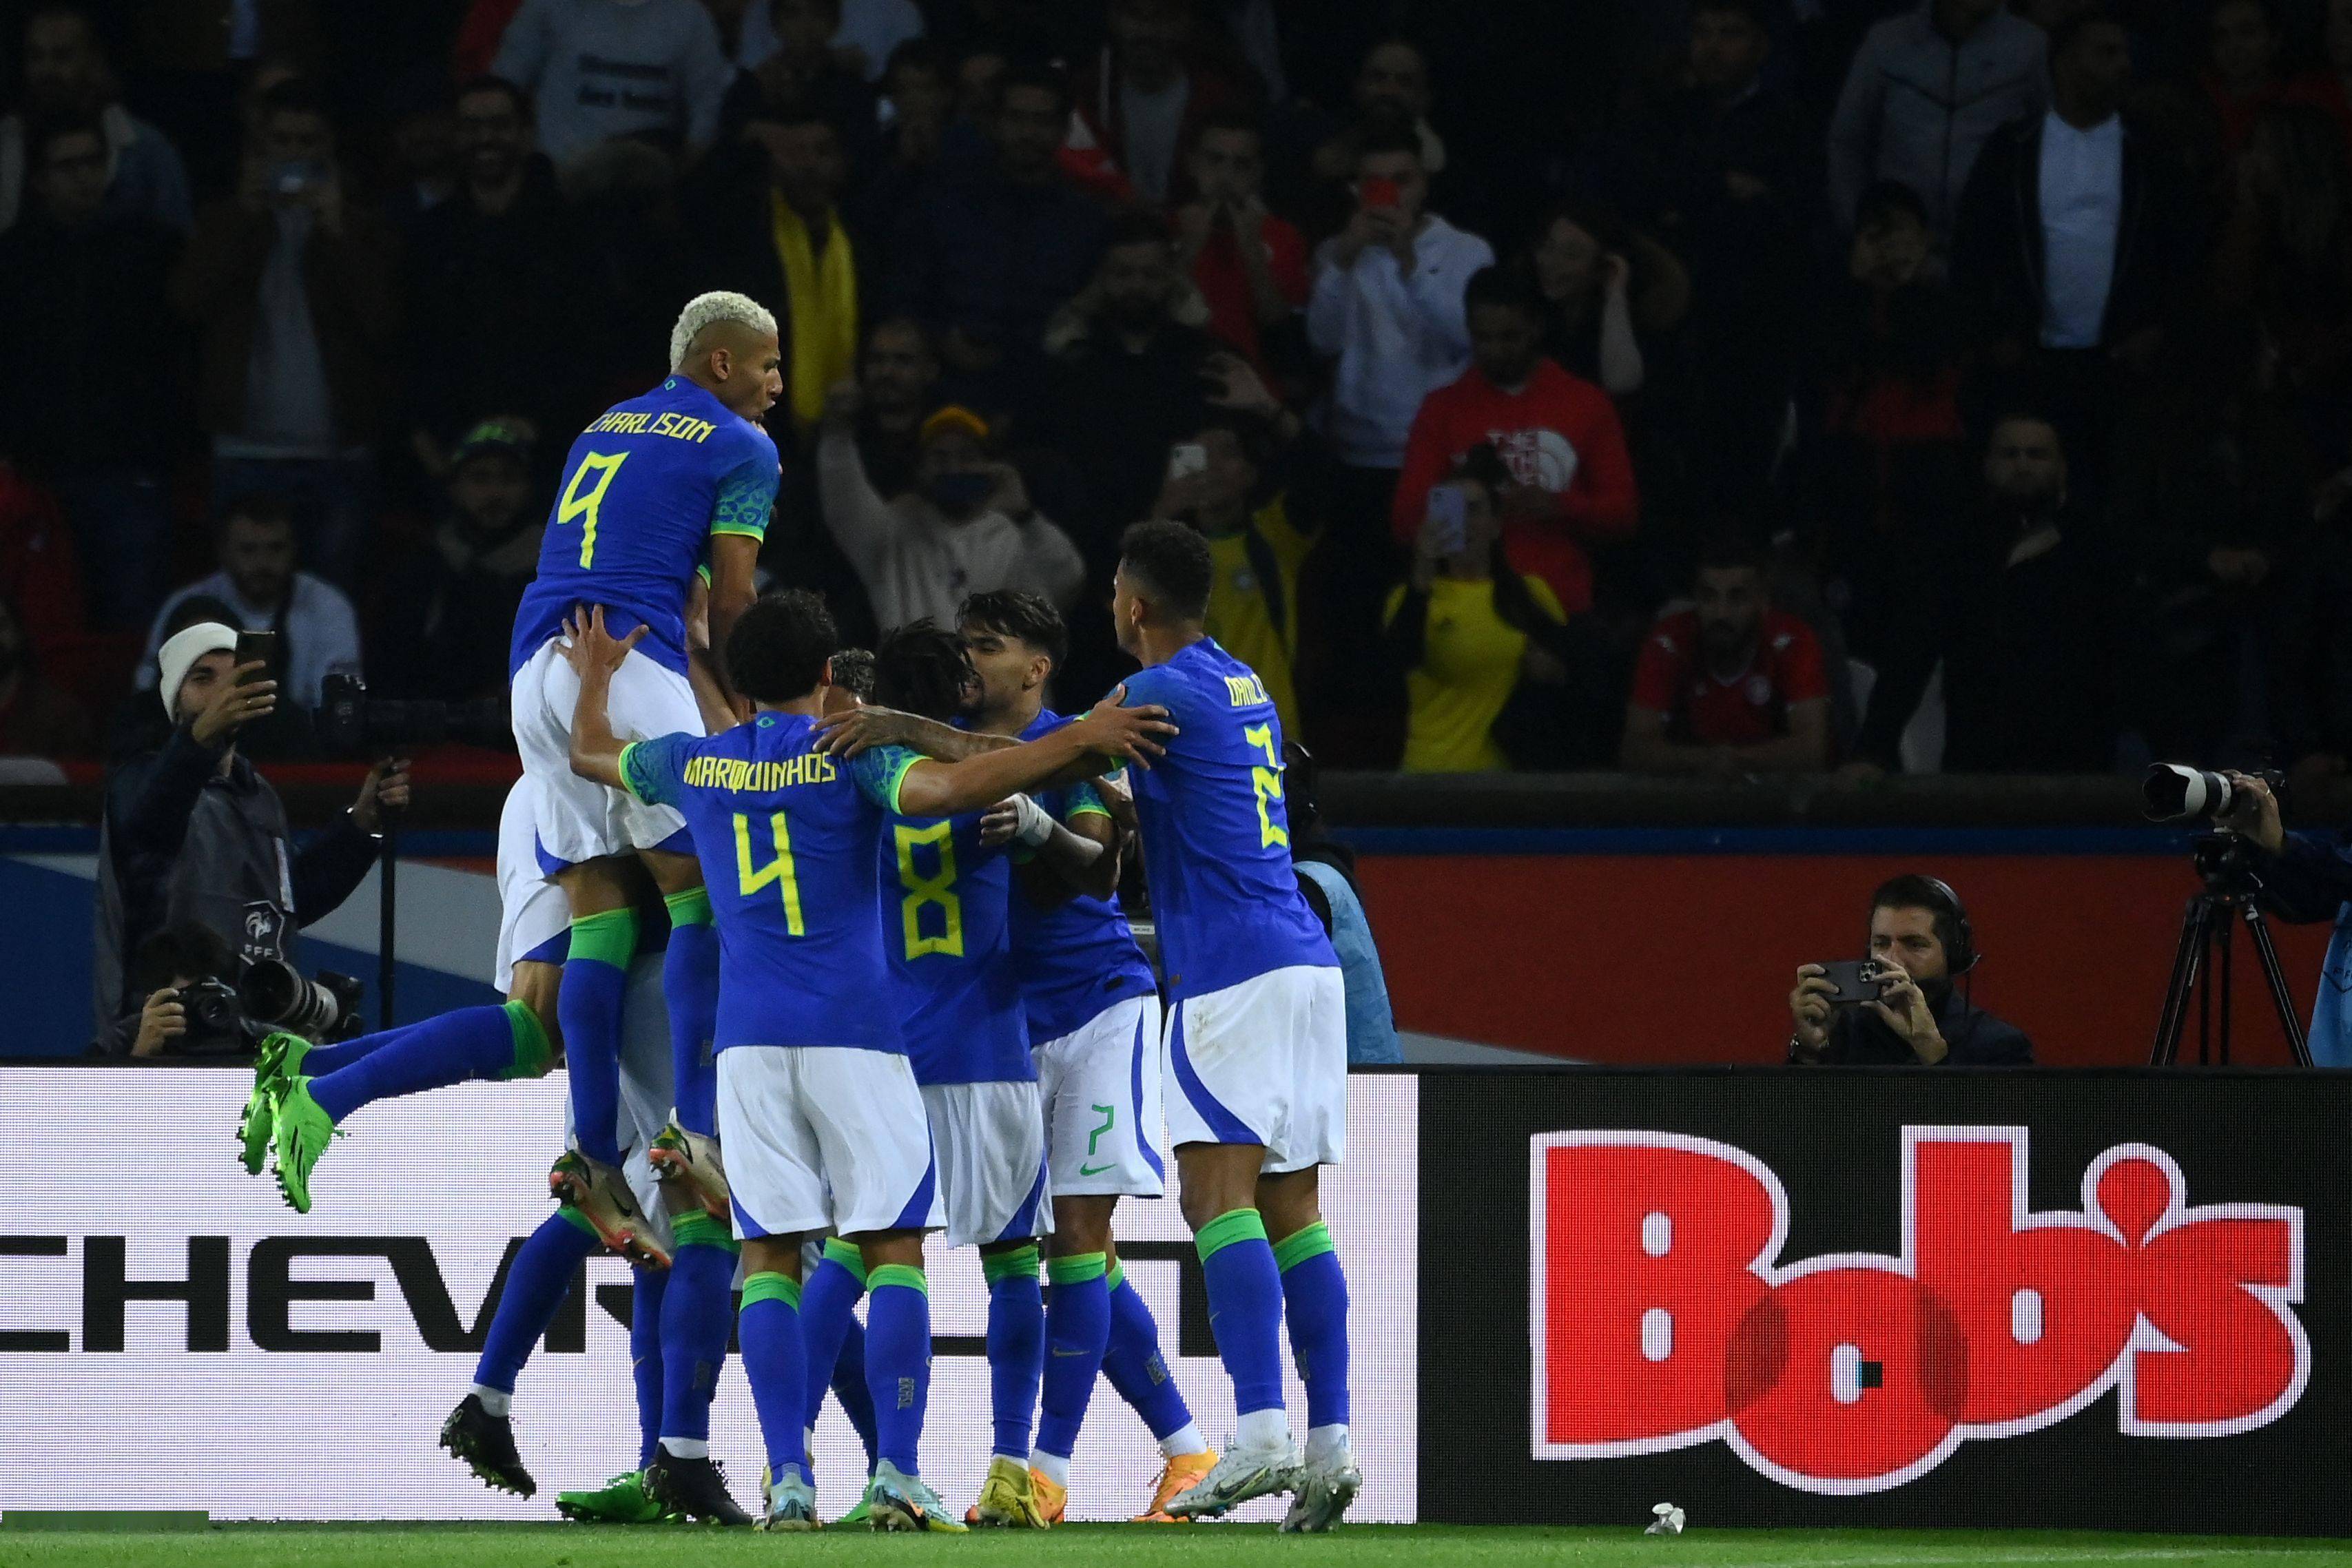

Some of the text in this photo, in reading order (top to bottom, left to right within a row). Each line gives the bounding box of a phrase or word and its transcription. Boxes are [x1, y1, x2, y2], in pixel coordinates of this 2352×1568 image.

[557, 451, 630, 570] 9
[683, 751, 836, 795] MARQUINHOS
[1244, 723, 1288, 849] 2
[732, 809, 805, 937] 4
[894, 819, 964, 962] 8
[1089, 1104, 1114, 1156] 7
